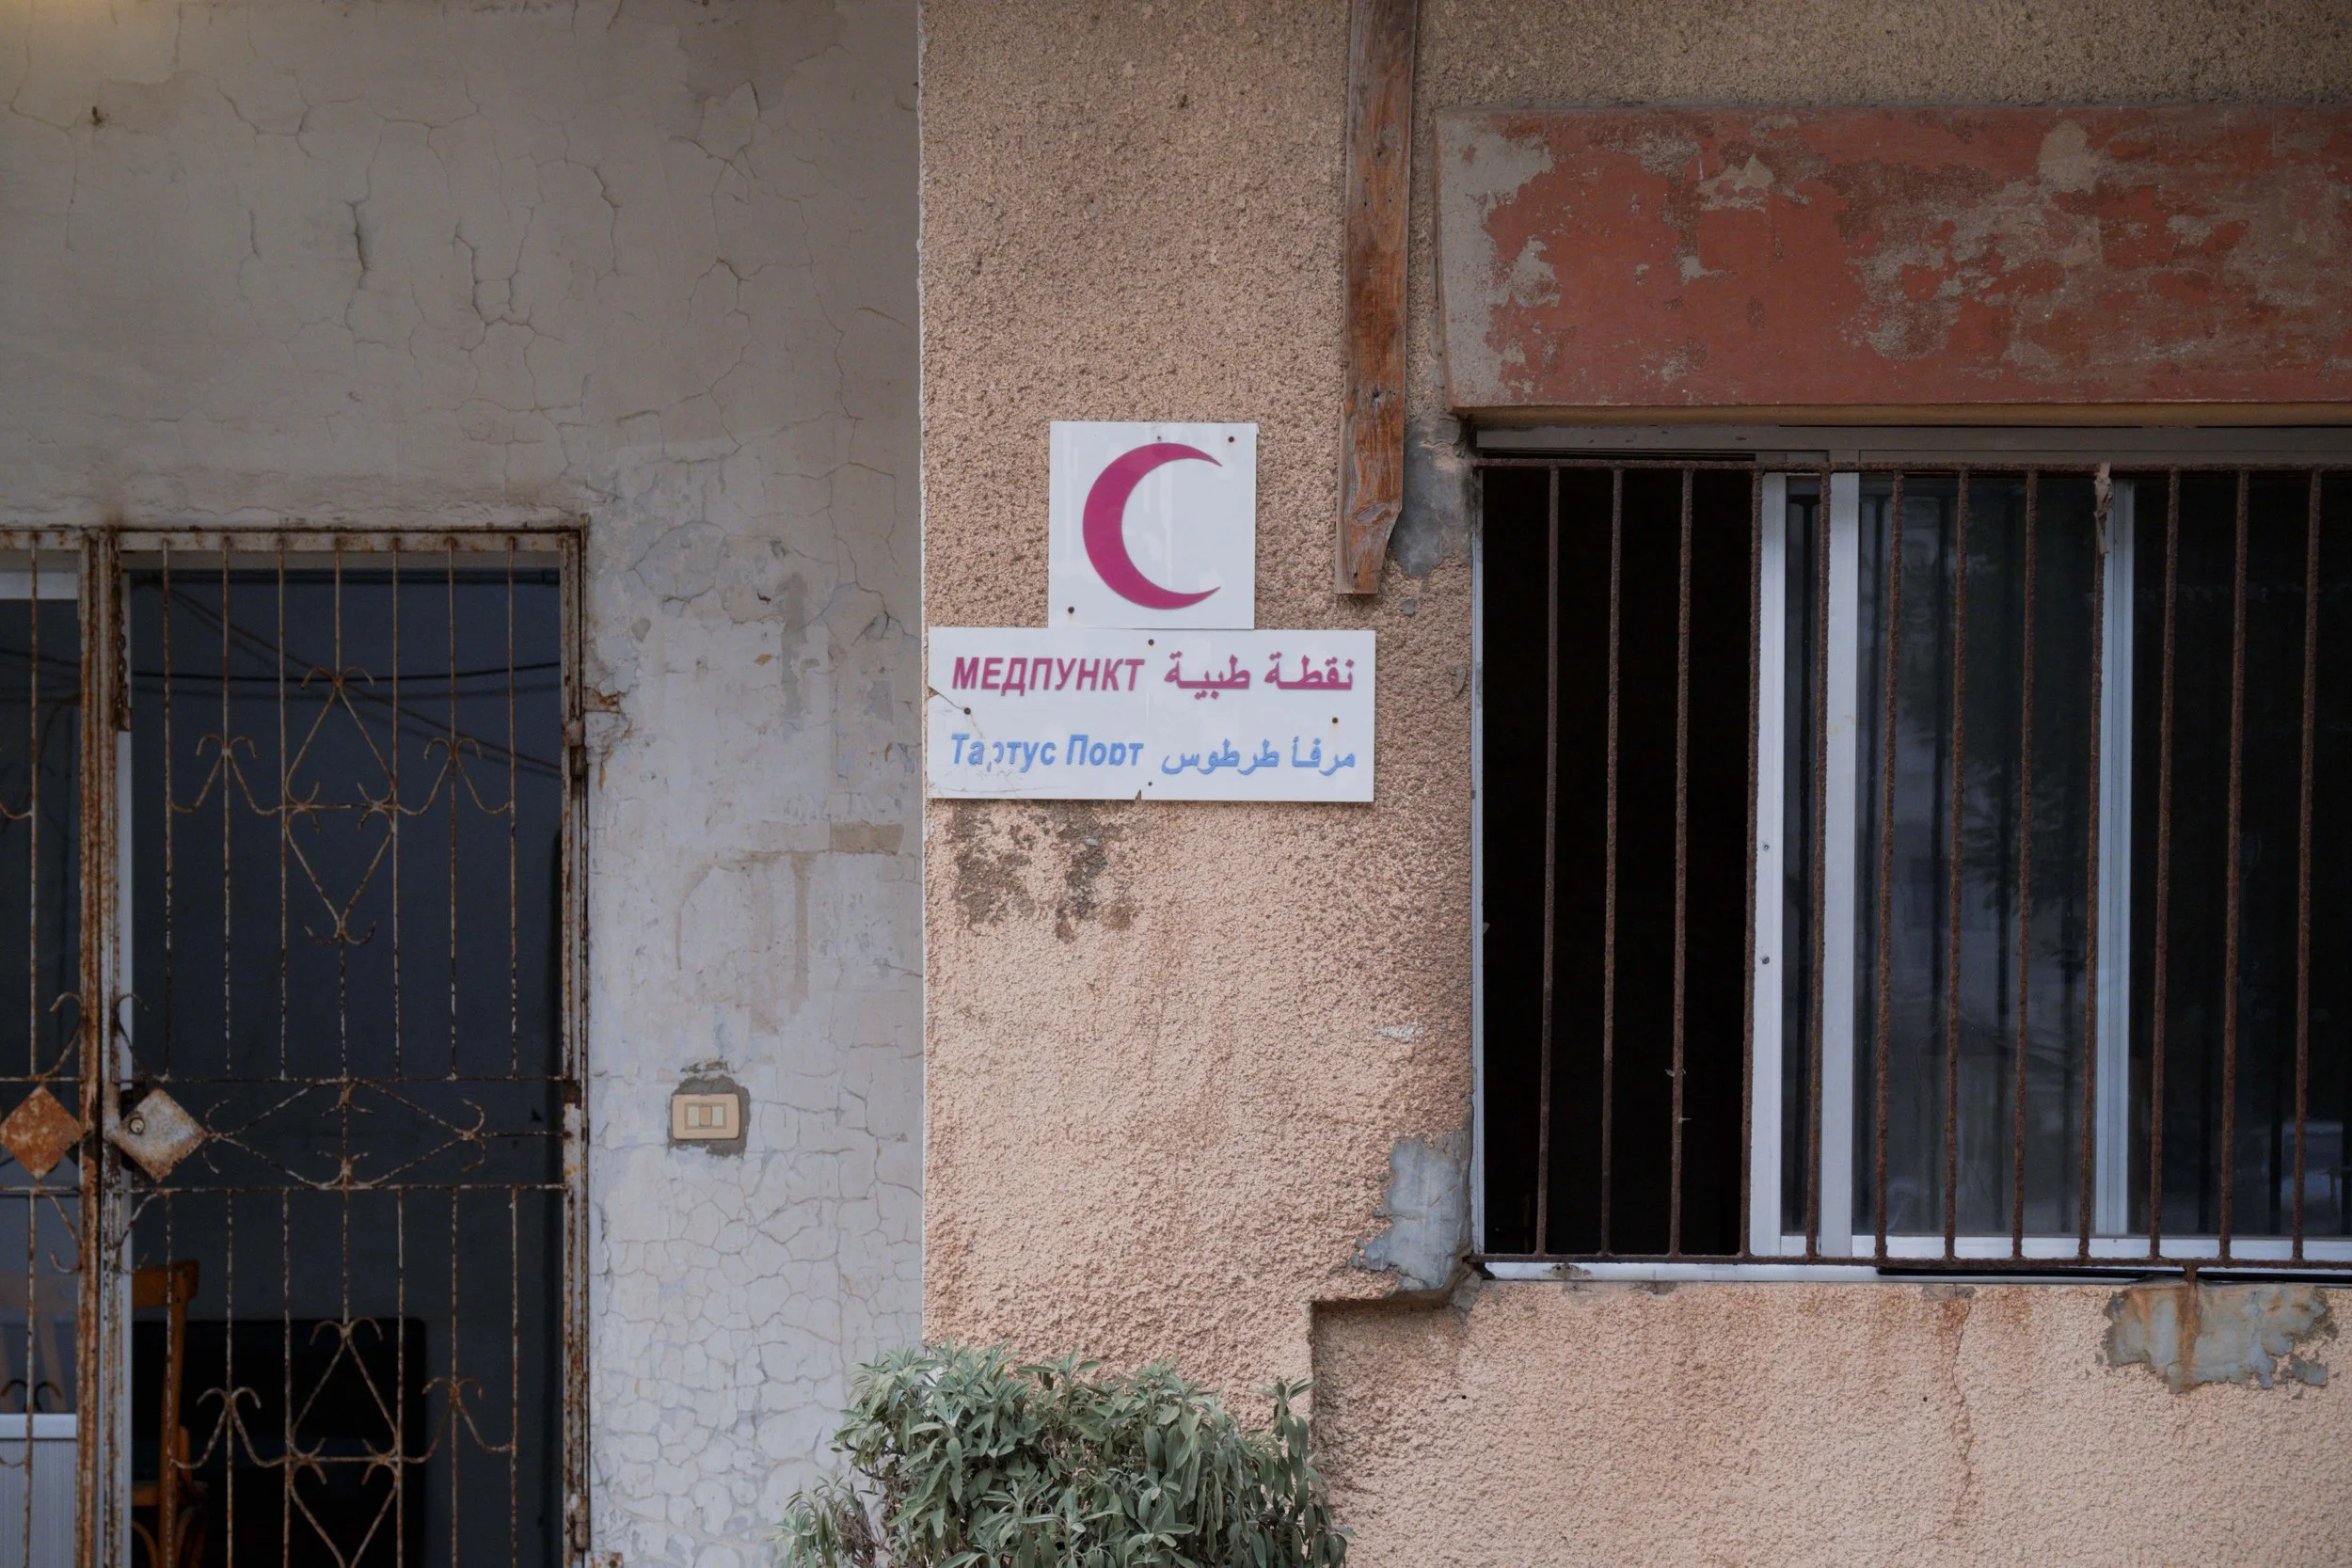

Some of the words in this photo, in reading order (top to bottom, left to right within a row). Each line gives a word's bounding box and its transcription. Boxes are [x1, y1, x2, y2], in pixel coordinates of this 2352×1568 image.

[952, 657, 1145, 696] МЕДПУНКТ
[1164, 651, 1250, 700] طبية
[1263, 651, 1354, 690] نقطة
[1161, 738, 1280, 776] طرطوس
[1291, 736, 1356, 777] مرفأ
